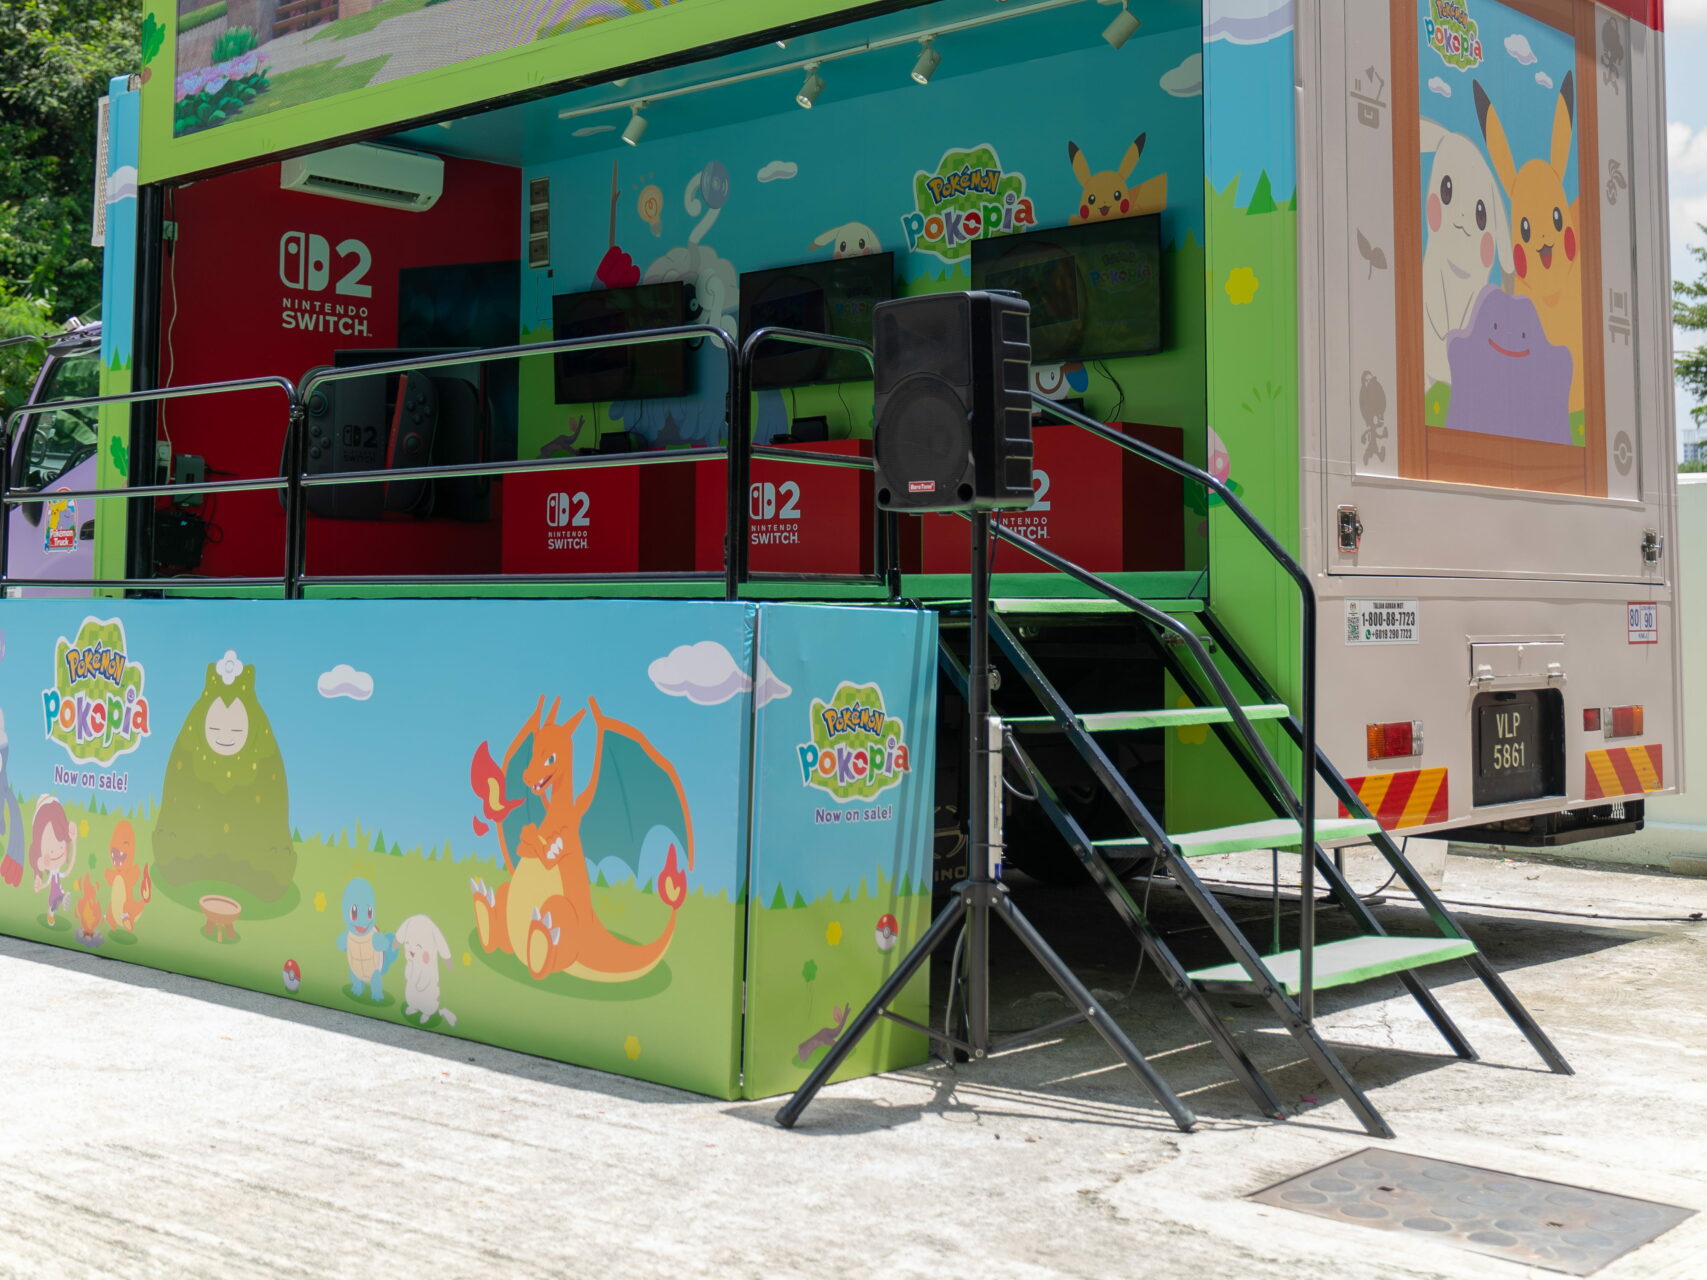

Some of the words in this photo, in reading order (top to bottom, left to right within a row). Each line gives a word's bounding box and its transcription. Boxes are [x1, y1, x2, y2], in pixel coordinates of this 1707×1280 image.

[335, 238, 372, 298] 2
[282, 297, 368, 317] NINTENDO
[281, 310, 368, 337] SWITCH
[571, 491, 590, 527] 2
[779, 480, 801, 519] 2
[547, 530, 588, 538] NINTENDO
[751, 523, 798, 532] NINTENDO
[547, 538, 588, 550] SWITCH
[751, 531, 798, 545] SWITCH
[1361, 611, 1416, 627] 1-800-88-7723
[1630, 608, 1640, 627] 80
[1644, 612, 1653, 628] 90
[1400, 629, 1412, 639] 7723
[1495, 711, 1521, 739] VLP
[1493, 741, 1525, 770] 5861
[54, 765, 79, 785] Now
[81, 773, 96, 788] on
[99, 772, 129, 792] sale!
[815, 808, 842, 823] Now
[845, 810, 860, 821] on
[863, 805, 893, 821] sale!
[934, 865, 967, 882] INO
